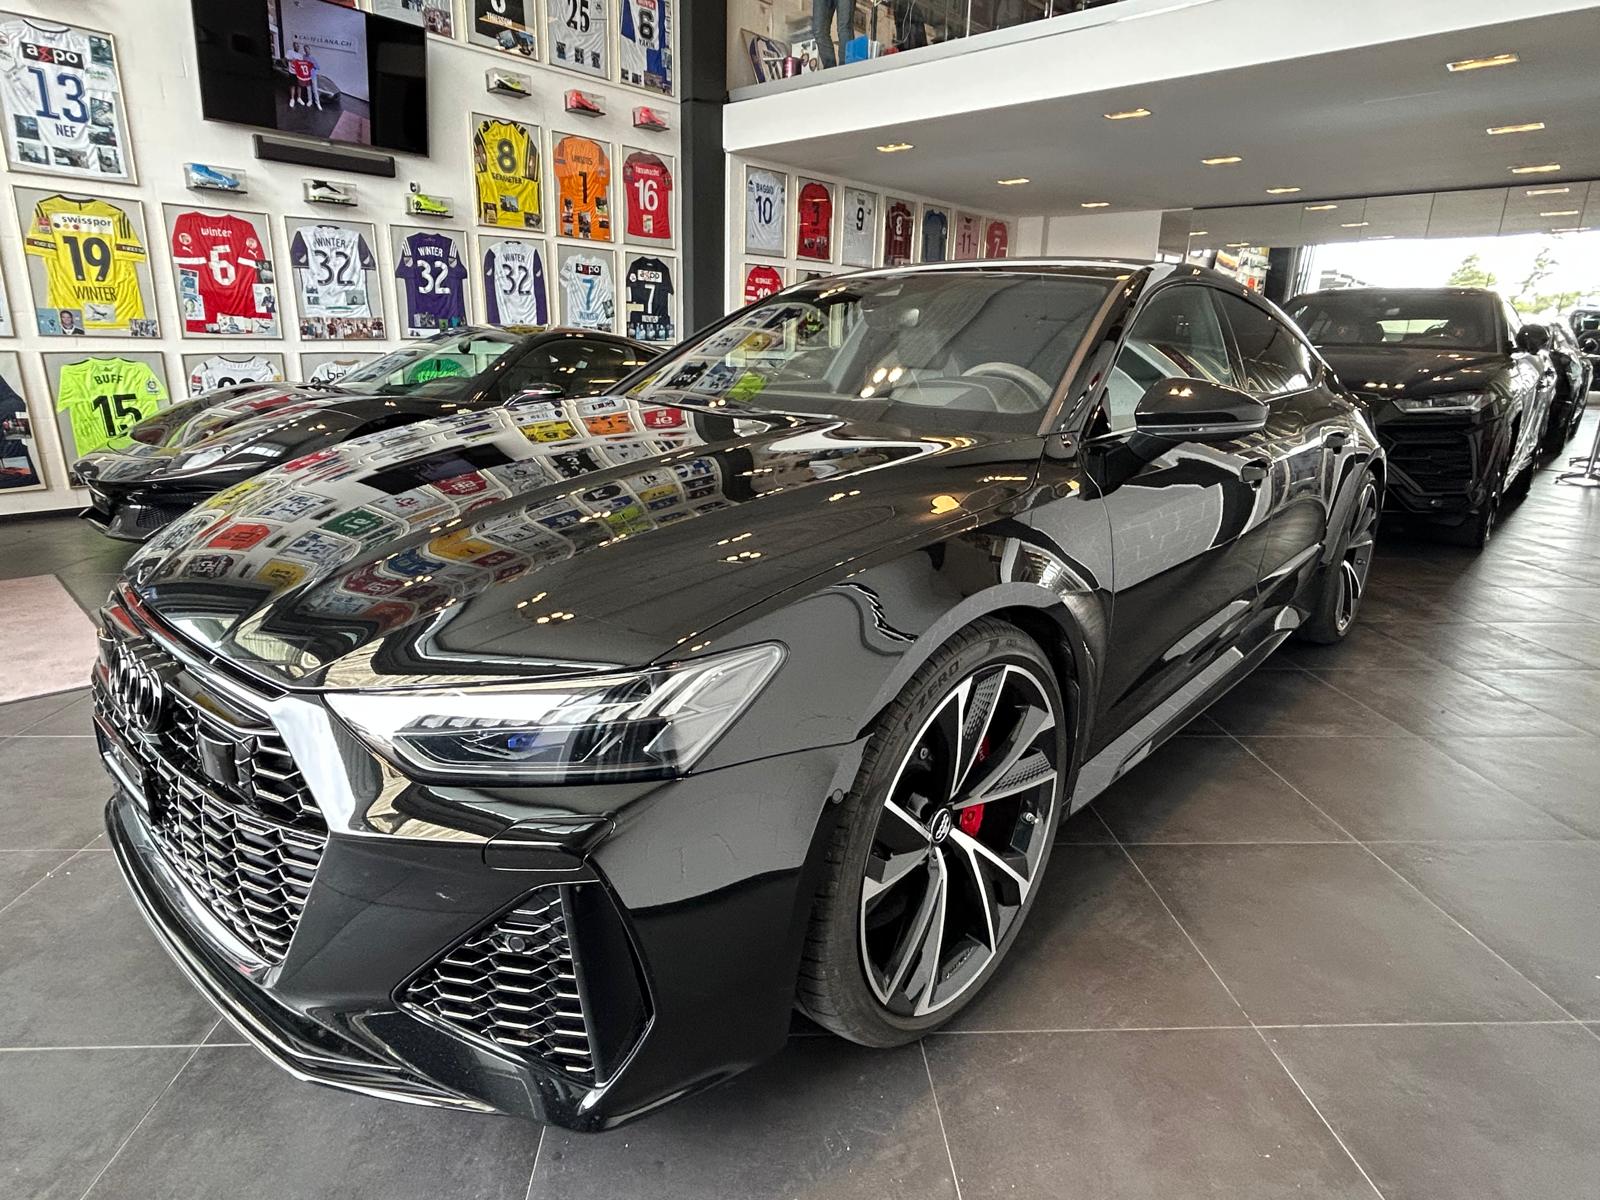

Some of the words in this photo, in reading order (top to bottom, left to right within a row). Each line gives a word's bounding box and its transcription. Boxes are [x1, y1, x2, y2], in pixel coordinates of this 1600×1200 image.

[567, 0, 590, 33] 25
[639, 8, 654, 40] 6
[27, 66, 90, 124] 13
[55, 123, 77, 138] NEF
[497, 138, 517, 174] 8
[579, 171, 588, 204] 1
[634, 178, 659, 211] 16
[62, 215, 112, 227] swisspor
[756, 195, 772, 225] 10
[856, 207, 865, 231] 9
[201, 227, 232, 237] winter
[316, 236, 347, 248] WINTER
[962, 231, 972, 254] 11
[62, 235, 112, 282] 19
[208, 244, 236, 286] 6
[314, 249, 356, 287] 32
[418, 247, 444, 257] WINTER
[73, 285, 118, 301] WINTER
[417, 259, 451, 295] 32
[502, 263, 532, 296] 32
[582, 278, 594, 311] 7
[644, 284, 656, 314] 7
[94, 373, 123, 385] BUFF
[91, 393, 143, 438] 15
[916, 660, 959, 713] ZERO
